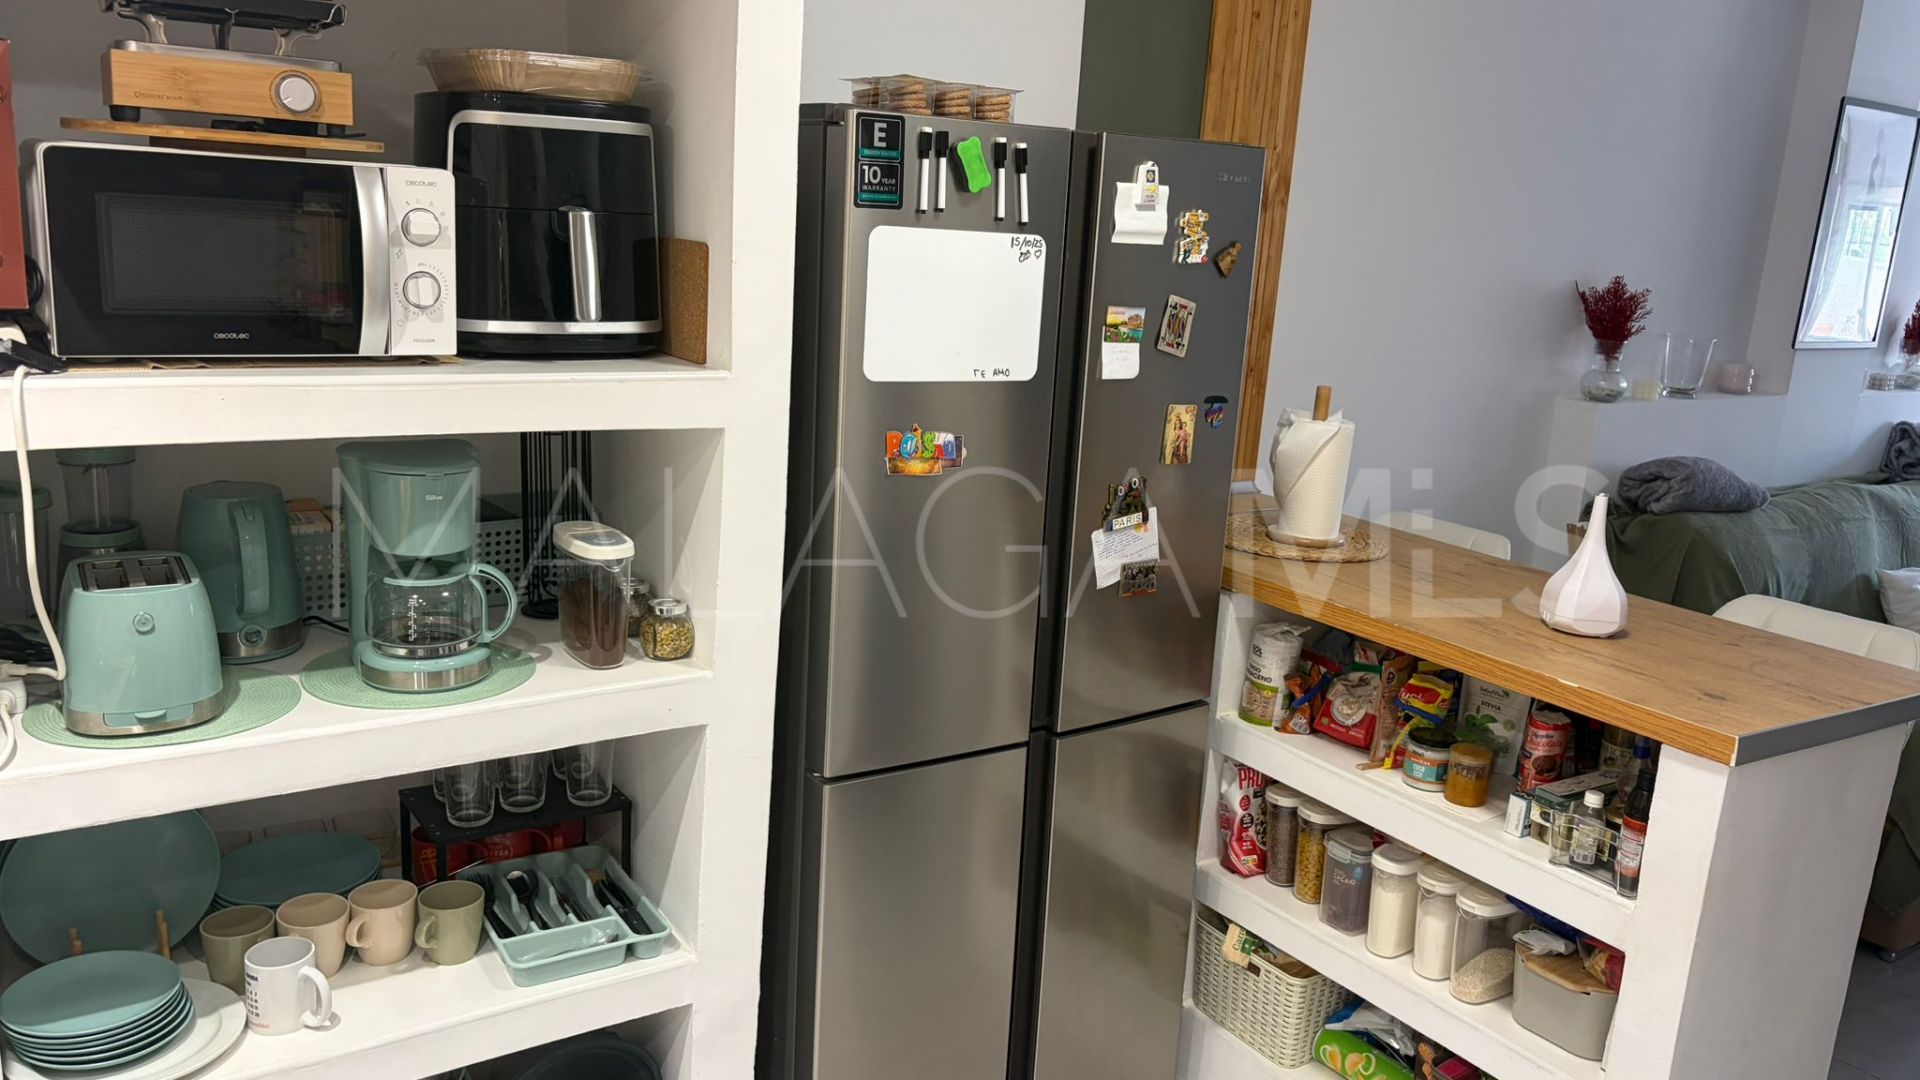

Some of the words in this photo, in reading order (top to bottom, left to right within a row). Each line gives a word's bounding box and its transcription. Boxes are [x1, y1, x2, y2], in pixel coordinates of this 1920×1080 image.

[873, 122, 887, 147] E
[862, 165, 881, 184] 10
[862, 184, 896, 192] WARRANTY
[1113, 514, 1142, 527] PARIS
